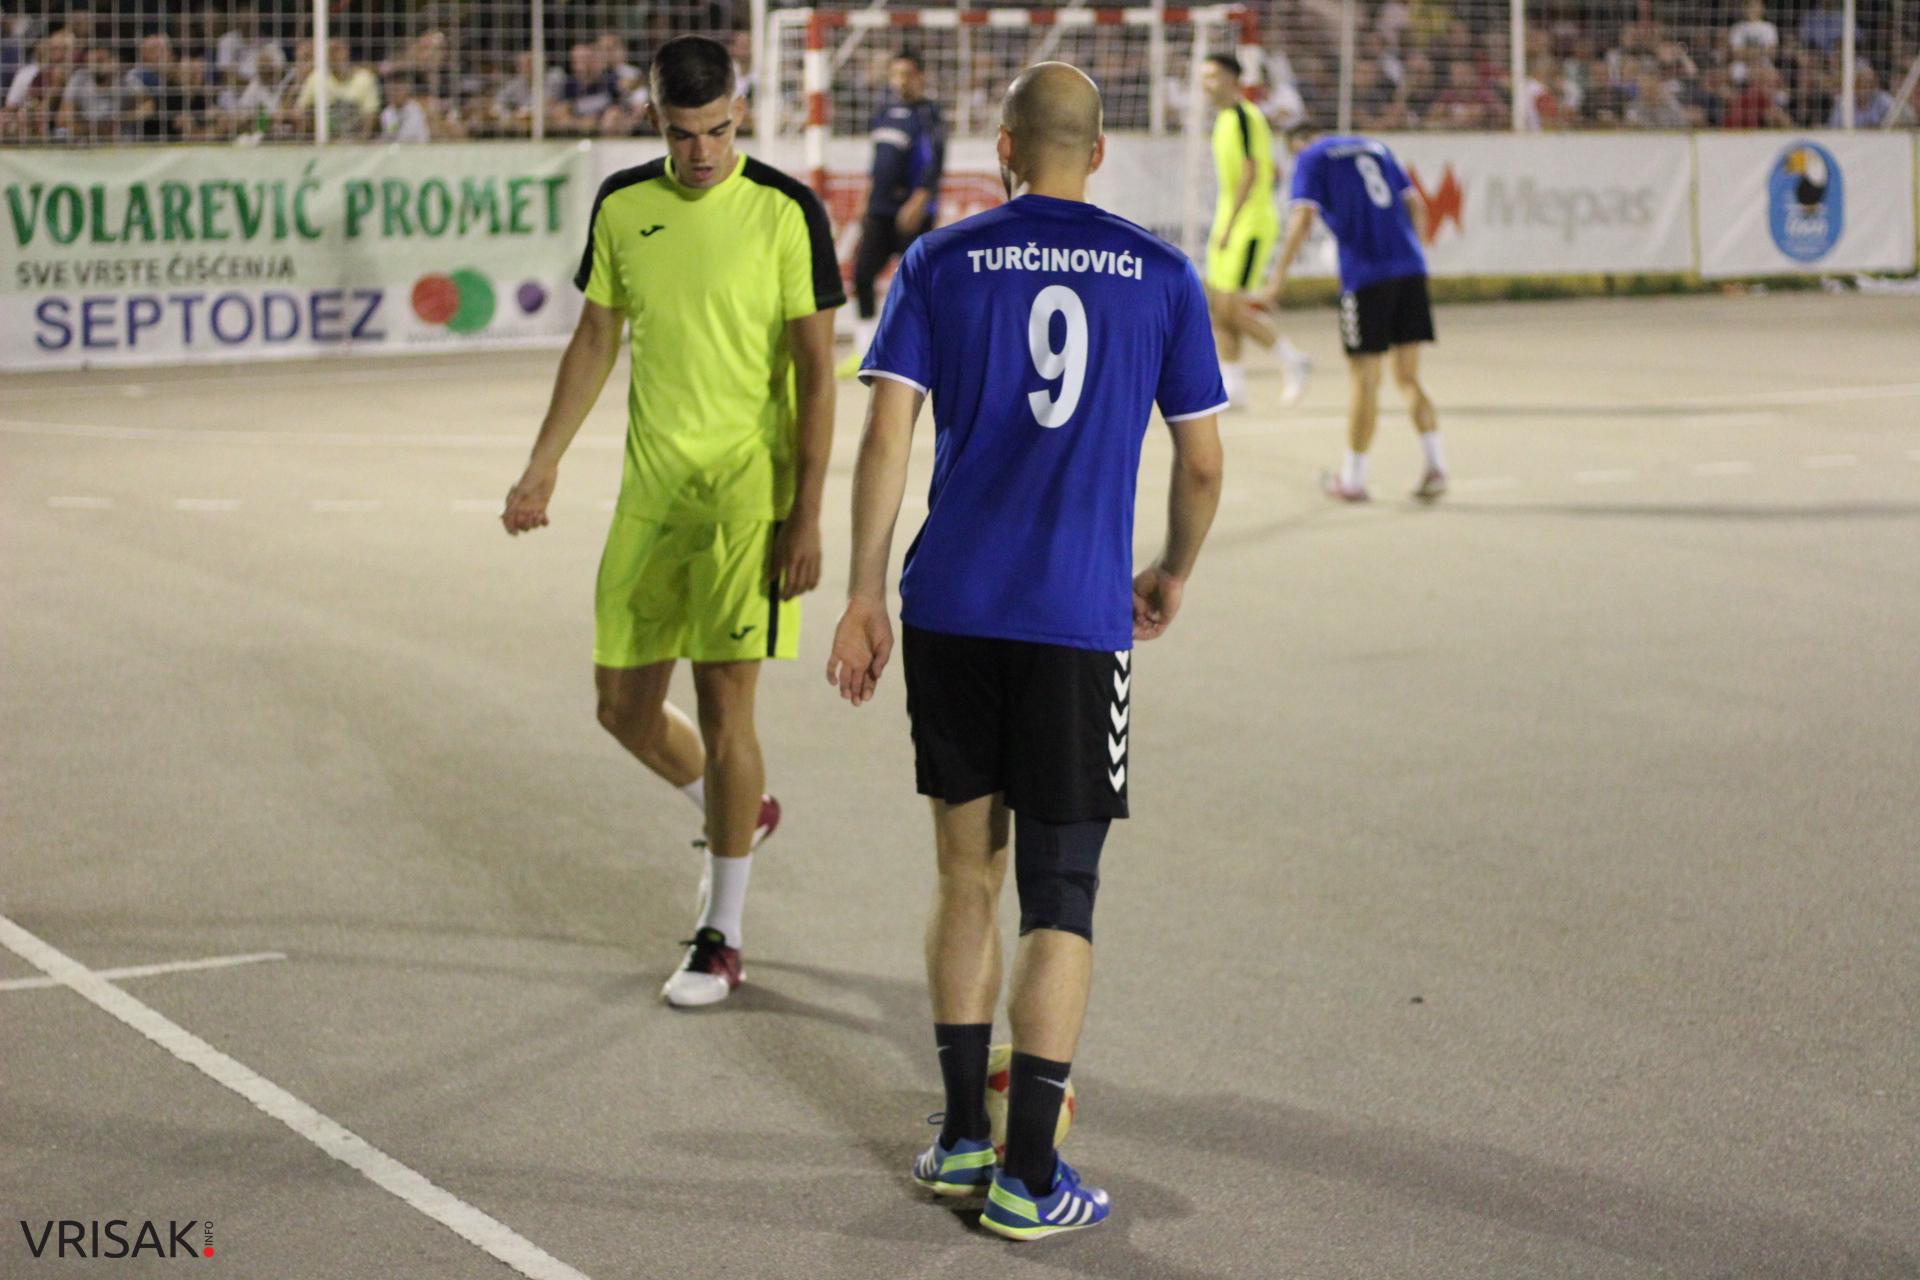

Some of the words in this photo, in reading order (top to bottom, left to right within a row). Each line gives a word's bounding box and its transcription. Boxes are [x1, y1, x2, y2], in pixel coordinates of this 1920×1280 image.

[5, 160, 323, 245] VOLAREVIĆ
[344, 174, 568, 239] PROMET
[1355, 155, 1392, 208] 8
[1484, 174, 1656, 241] Mepas
[15, 260, 66, 287] SVE
[73, 257, 160, 286] VRSTE
[967, 242, 1143, 280] TURČINOVIĆI
[35, 291, 385, 350] SEPTODEZ
[1028, 285, 1088, 428] 9
